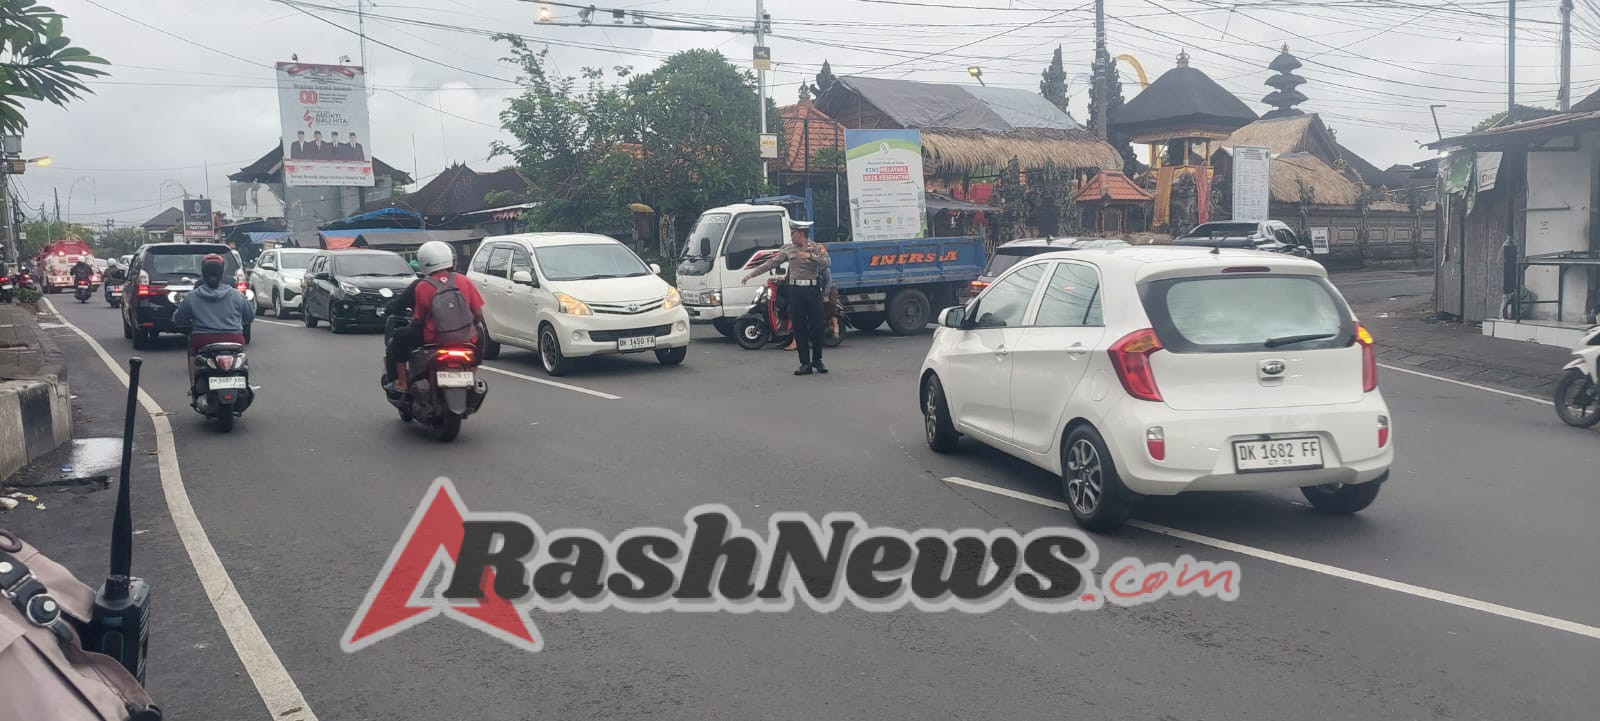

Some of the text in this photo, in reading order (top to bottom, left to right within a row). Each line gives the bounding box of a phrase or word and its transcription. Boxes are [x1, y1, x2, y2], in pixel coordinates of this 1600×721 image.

[1239, 441, 1318, 461] DK 1682 FF
